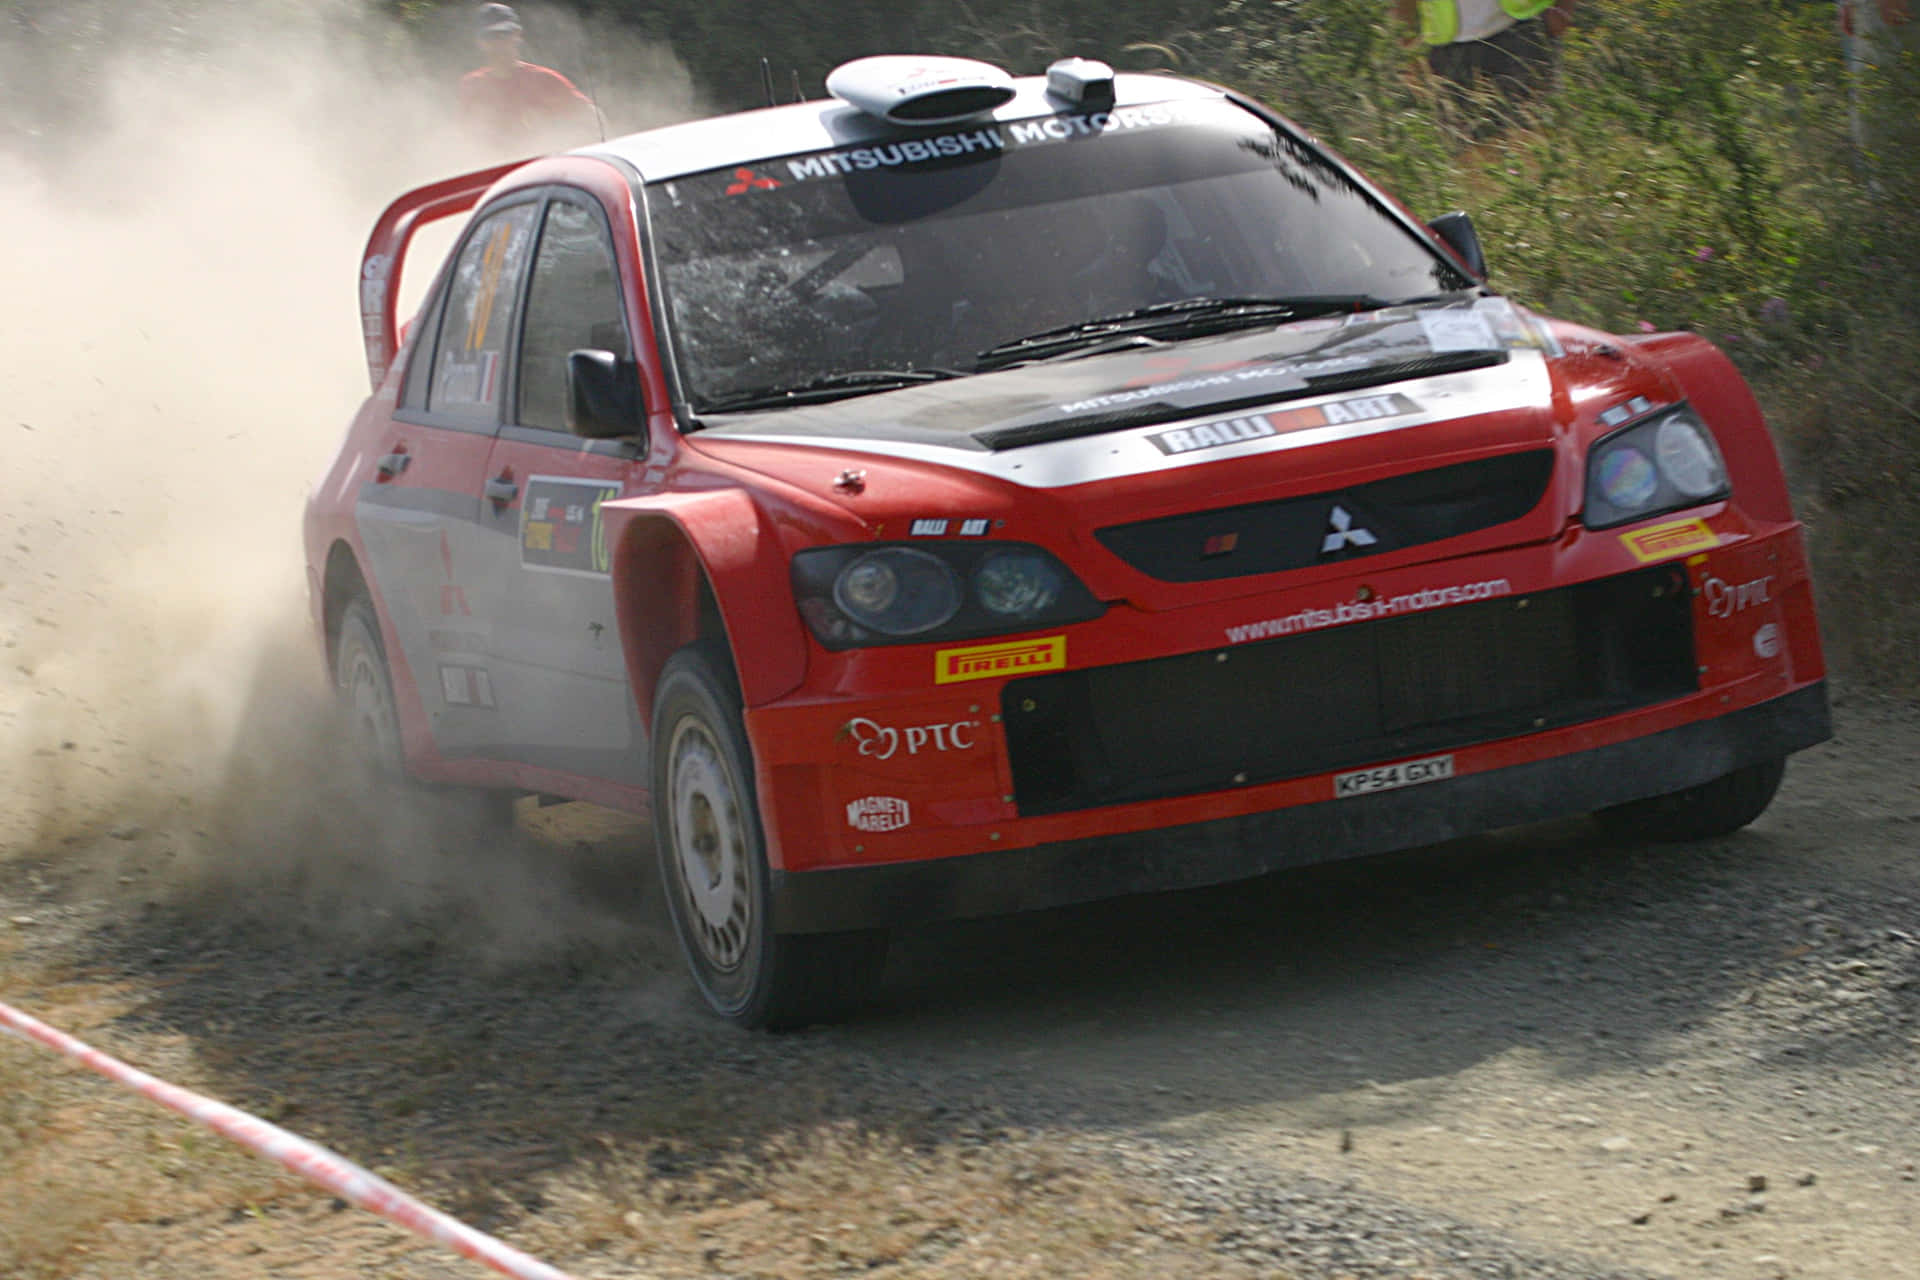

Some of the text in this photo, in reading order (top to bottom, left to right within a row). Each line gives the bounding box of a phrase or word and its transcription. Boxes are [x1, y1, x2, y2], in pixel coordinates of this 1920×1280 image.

[786, 127, 1005, 181] MITSUBISHI
[1163, 394, 1403, 453] RALLI ART
[946, 643, 1053, 676] PIRELLI
[904, 720, 973, 754] PTC
